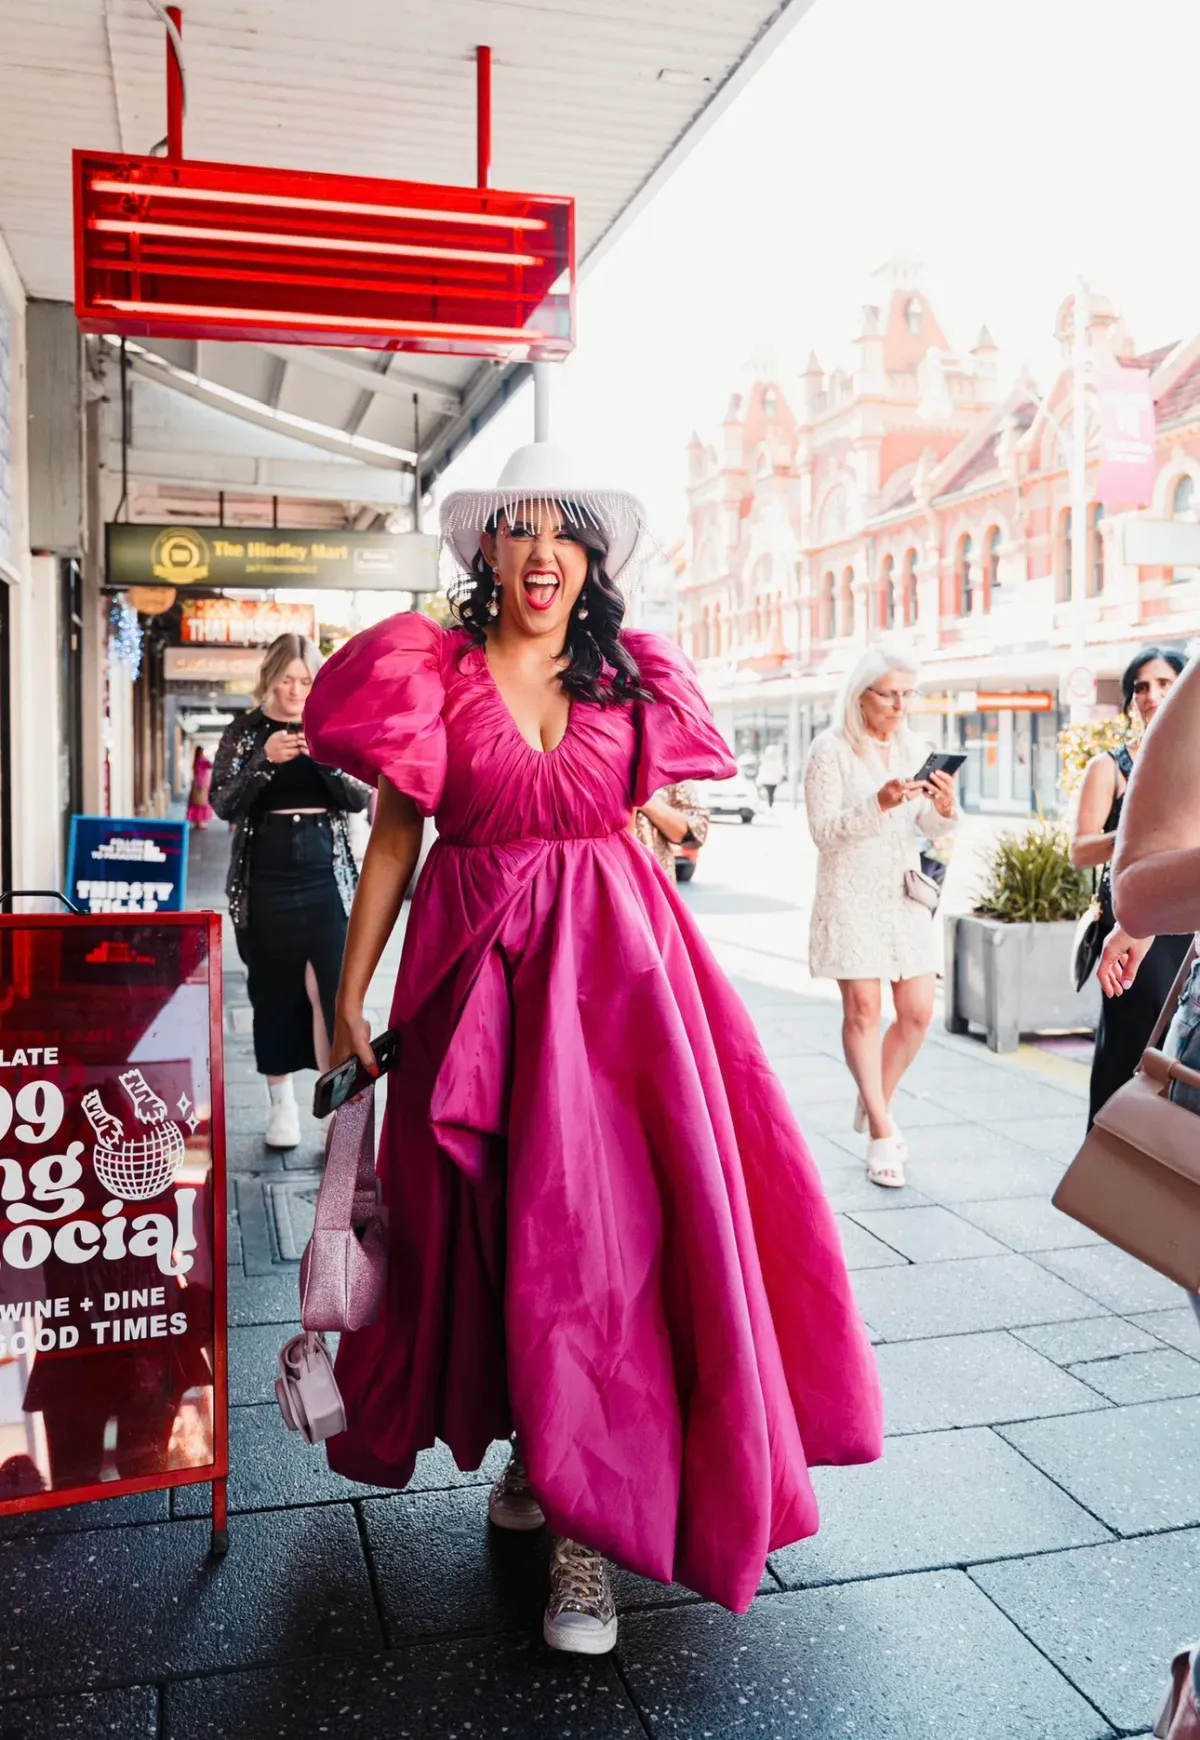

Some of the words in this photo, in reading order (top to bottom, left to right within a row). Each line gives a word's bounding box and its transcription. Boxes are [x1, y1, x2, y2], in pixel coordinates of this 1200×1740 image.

[213, 540, 244, 557] The
[247, 542, 308, 562] Hindley
[310, 544, 347, 559] Mart
[77, 880, 174, 902] THIRSTY
[0, 1047, 59, 1066] LATE
[0, 1080, 65, 1144] 9
[0, 1188, 197, 1276] ocial
[0, 1297, 70, 1322] WINE
[104, 1286, 165, 1311] DINE
[91, 1312, 187, 1345] TIMES
